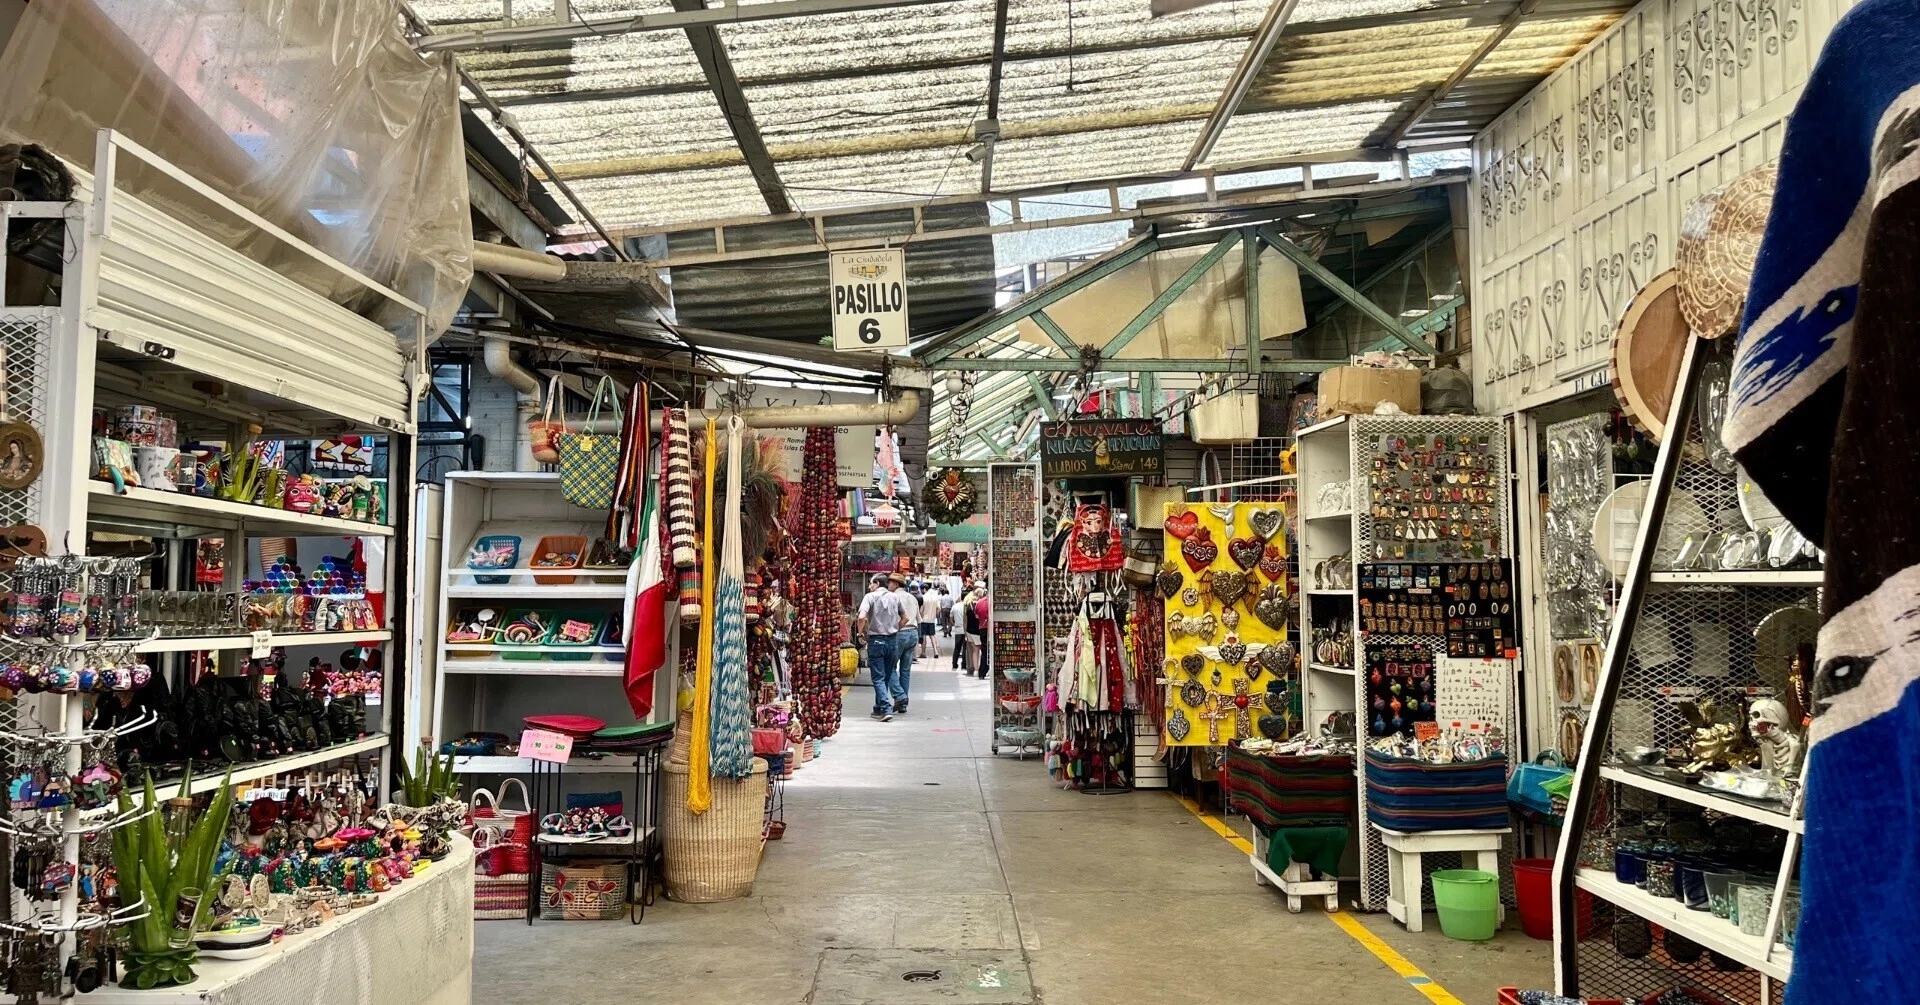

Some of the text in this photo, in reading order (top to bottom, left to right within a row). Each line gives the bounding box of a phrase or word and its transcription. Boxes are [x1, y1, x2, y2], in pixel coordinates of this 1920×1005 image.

[842, 252, 893, 264] La Ciudadela
[835, 282, 903, 315] PASILLO
[859, 318, 882, 345] 6
[1591, 369, 1610, 387] CAL
[1044, 422, 1134, 437] CARNAVAL
[787, 436, 805, 444] Rome
[1107, 435, 1161, 452] MEXICANAS
[1109, 458, 1135, 471] Stand
[1140, 457, 1158, 470] 149
